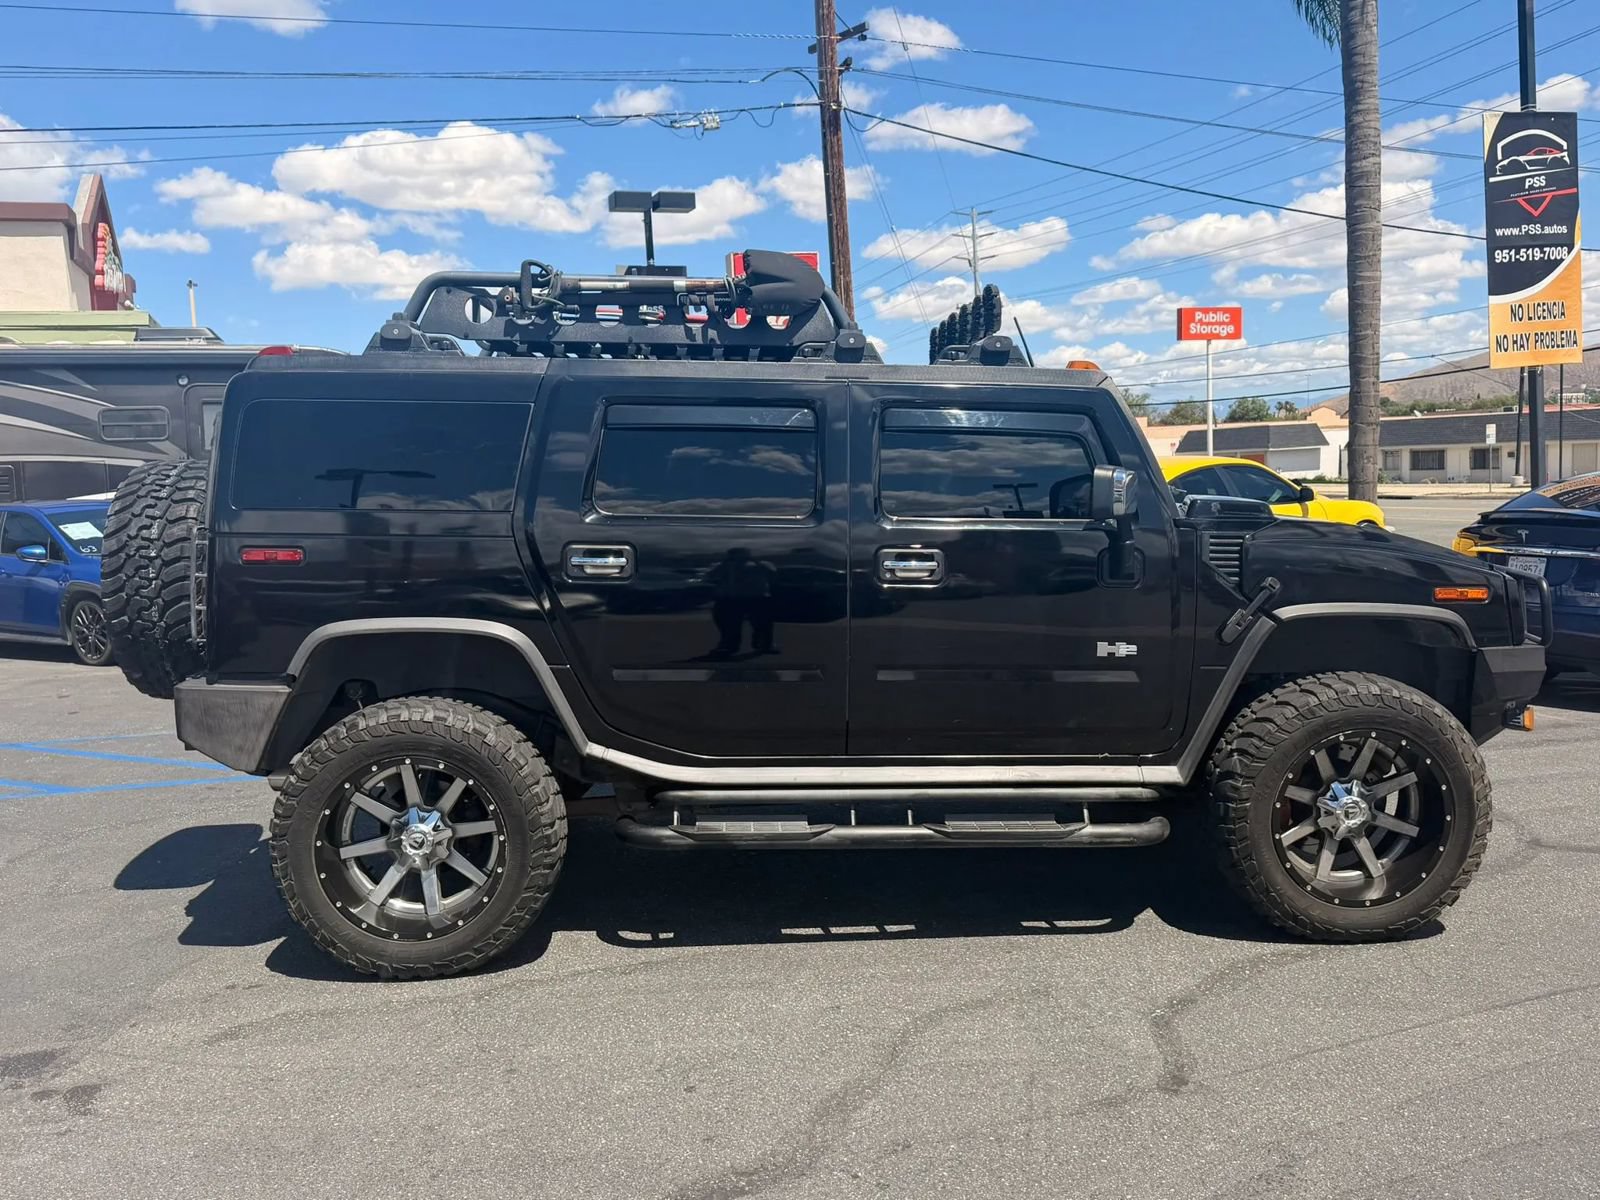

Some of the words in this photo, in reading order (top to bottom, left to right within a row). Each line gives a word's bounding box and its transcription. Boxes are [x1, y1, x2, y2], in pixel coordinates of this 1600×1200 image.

[1525, 175, 1546, 189] PSS
[1495, 224, 1568, 237] www.PSS.autos
[1494, 246, 1569, 263] 951-519-7008
[1194, 311, 1231, 322] Public
[1510, 303, 1524, 322] NO
[1527, 301, 1566, 321] LICENCIA
[1189, 323, 1235, 336] Storage
[1496, 334, 1509, 353] NO
[1512, 332, 1531, 351] HAY
[1534, 330, 1578, 350] PROBLEMA
[1097, 642, 1137, 657] H2
